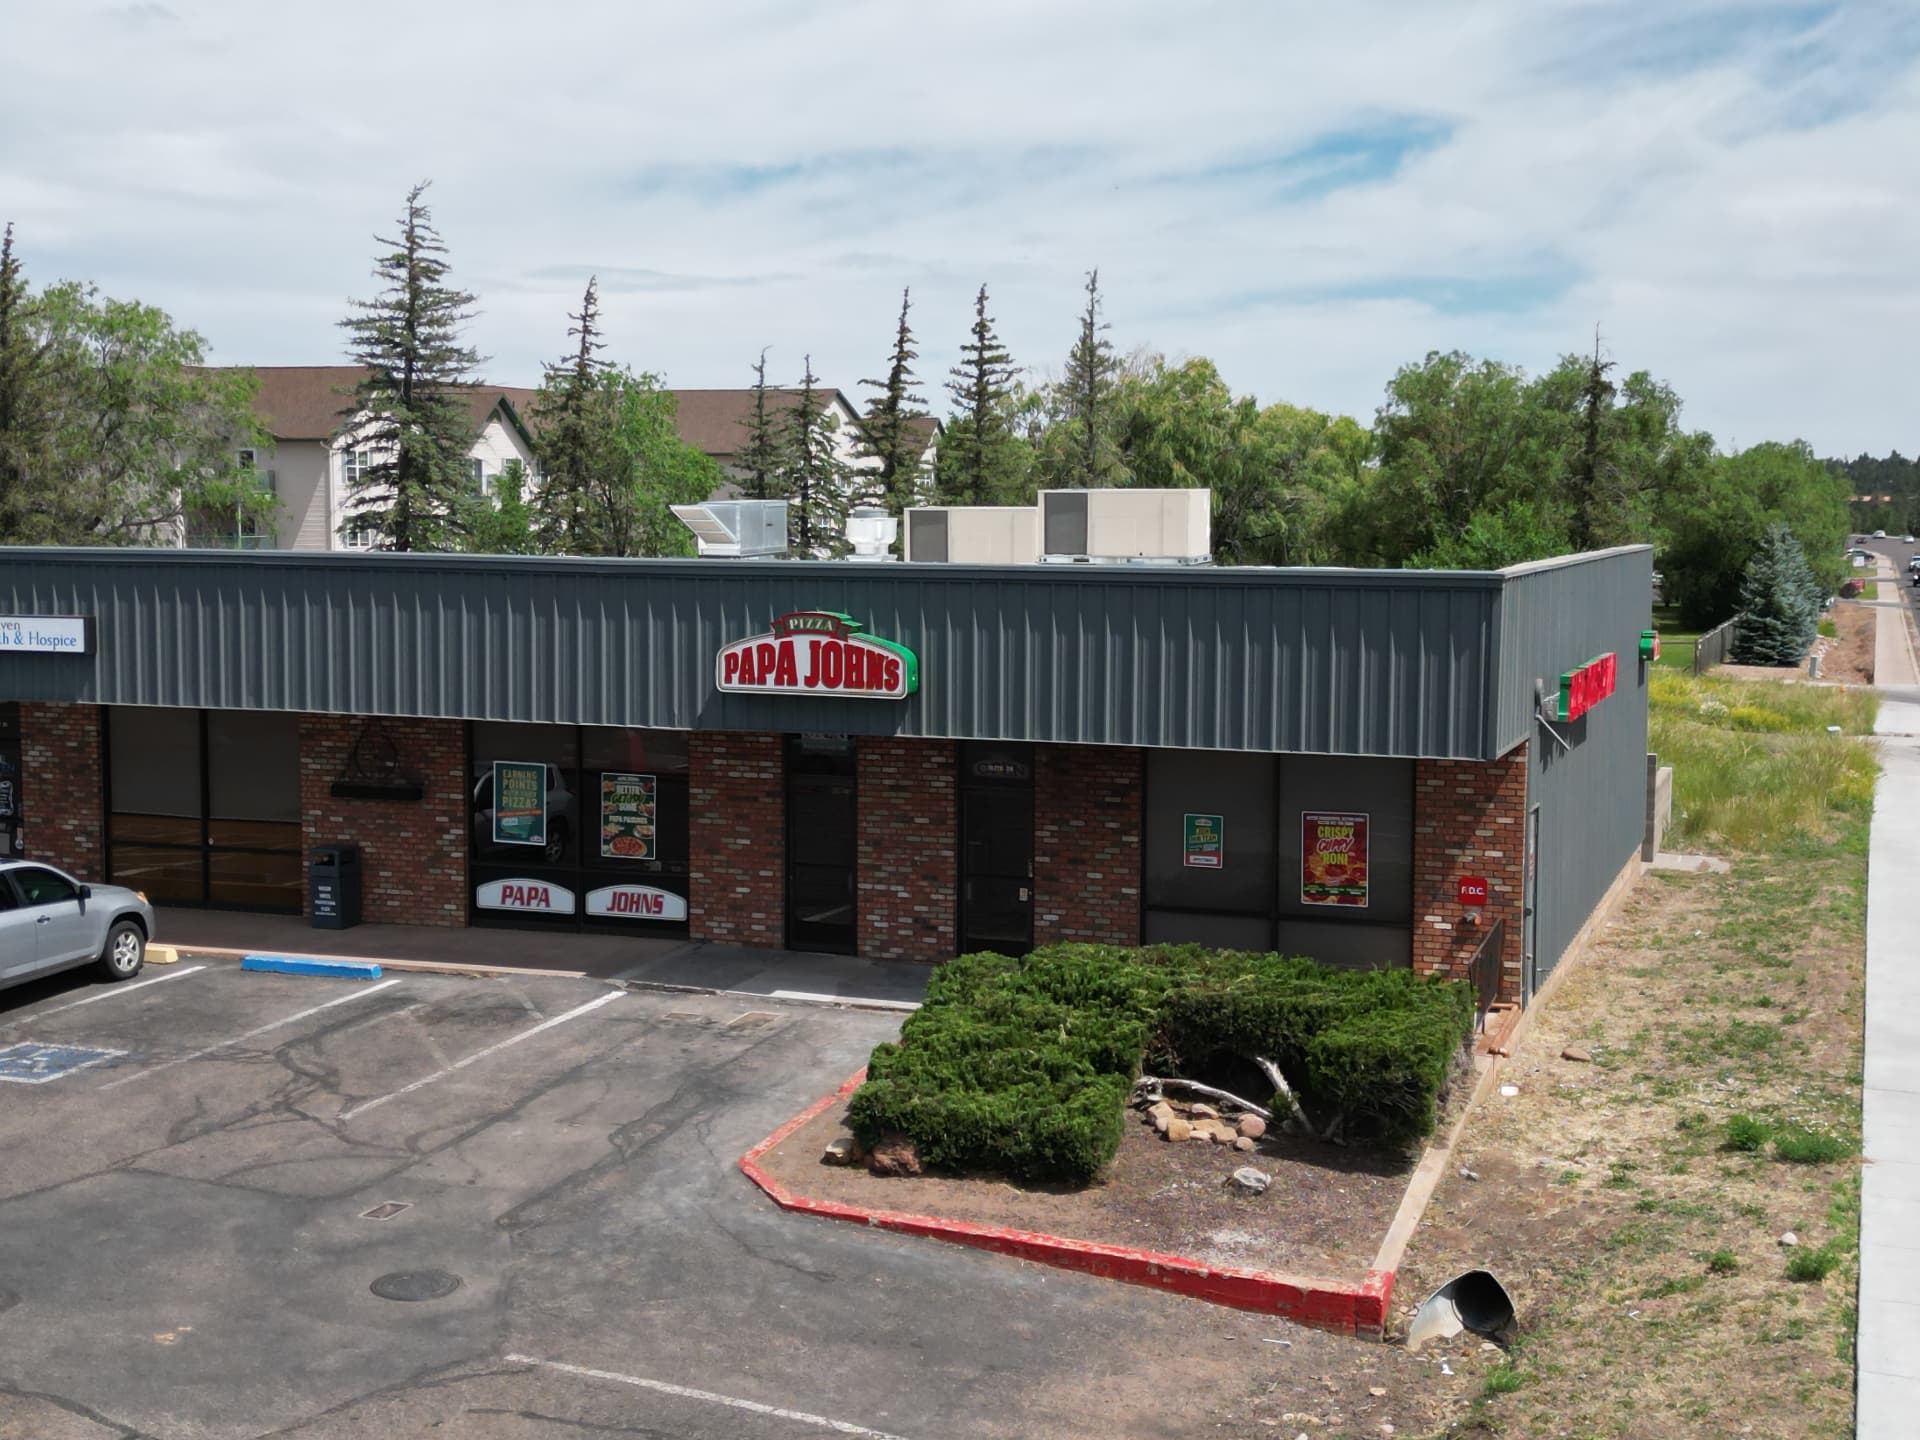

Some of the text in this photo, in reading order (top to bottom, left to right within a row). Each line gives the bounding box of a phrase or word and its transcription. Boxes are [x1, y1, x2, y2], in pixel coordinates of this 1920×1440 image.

[788, 617, 834, 632] PIZZA
[14, 631, 24, 645] &
[28, 631, 77, 650] Hospice
[724, 640, 798, 687] PAPA
[502, 797, 537, 809] PIZZA?
[1317, 826, 1354, 839] CRISPY
[501, 885, 551, 908] PAPA
[606, 892, 665, 915] JOHNS
